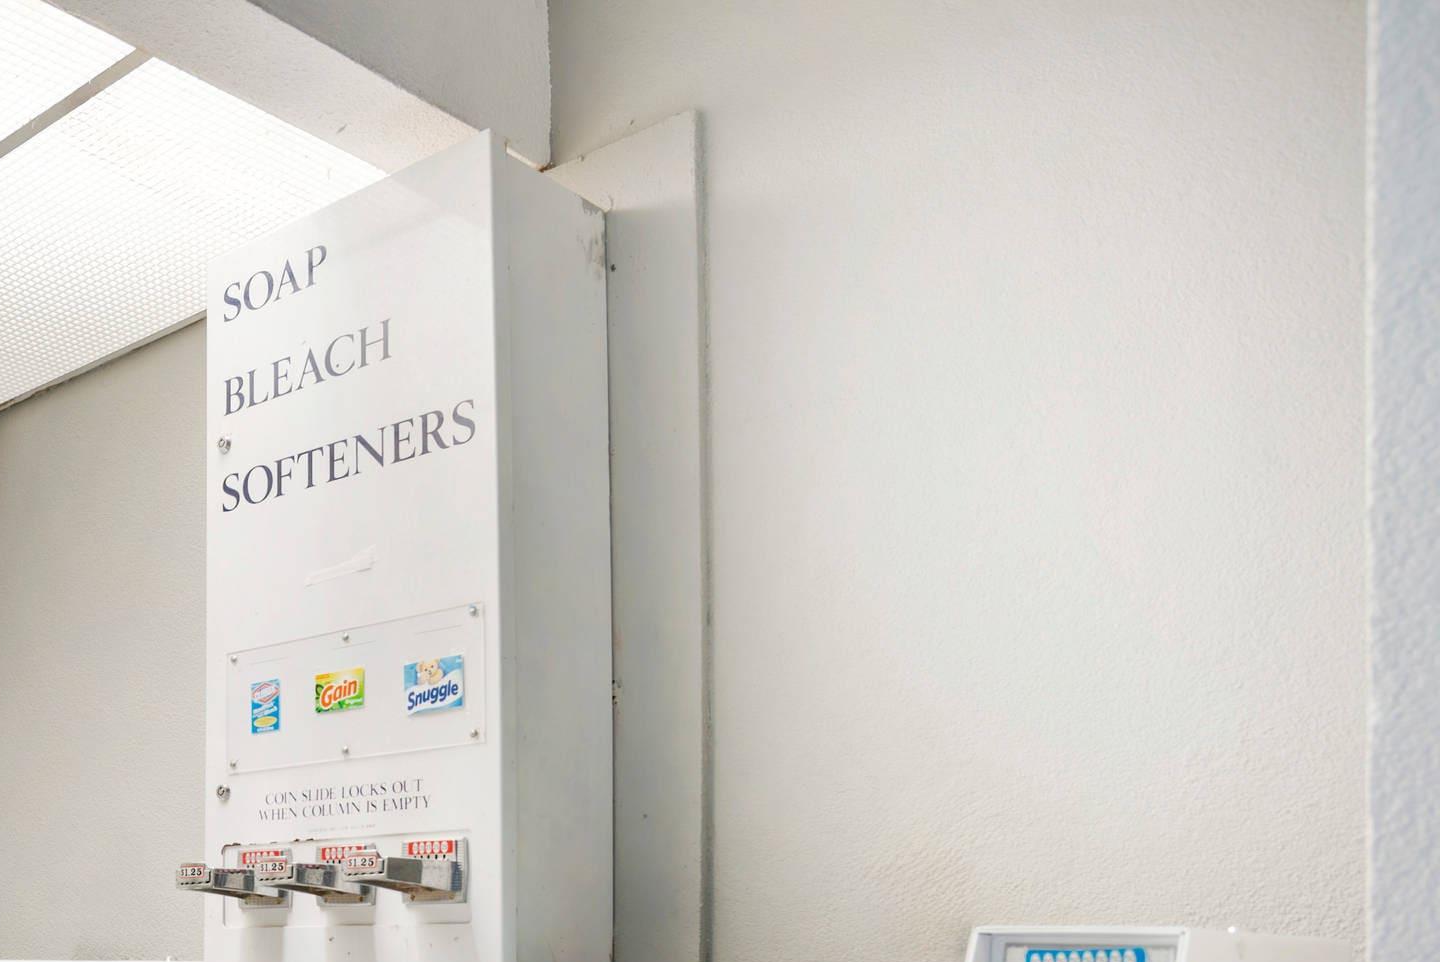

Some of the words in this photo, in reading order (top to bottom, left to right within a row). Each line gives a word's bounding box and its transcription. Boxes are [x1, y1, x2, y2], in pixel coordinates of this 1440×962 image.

[223, 245, 327, 323] SOAP
[224, 318, 392, 416] BLEACH
[222, 399, 476, 513] SOFTENERS
[321, 680, 358, 708] Gain
[408, 680, 459, 710] Snuggle
[265, 791, 297, 805] COIN
[302, 787, 337, 802] SLIDE
[341, 783, 387, 799] LOCKS
[392, 779, 424, 794] OUT
[258, 807, 298, 821] WHEN
[302, 802, 361, 818] COLUMN
[366, 799, 378, 813] IS
[383, 795, 432, 812] EMPTY
[180, 867, 202, 876] $1.25
[260, 862, 284, 872] $1.25
[348, 857, 374, 867] $1.25
